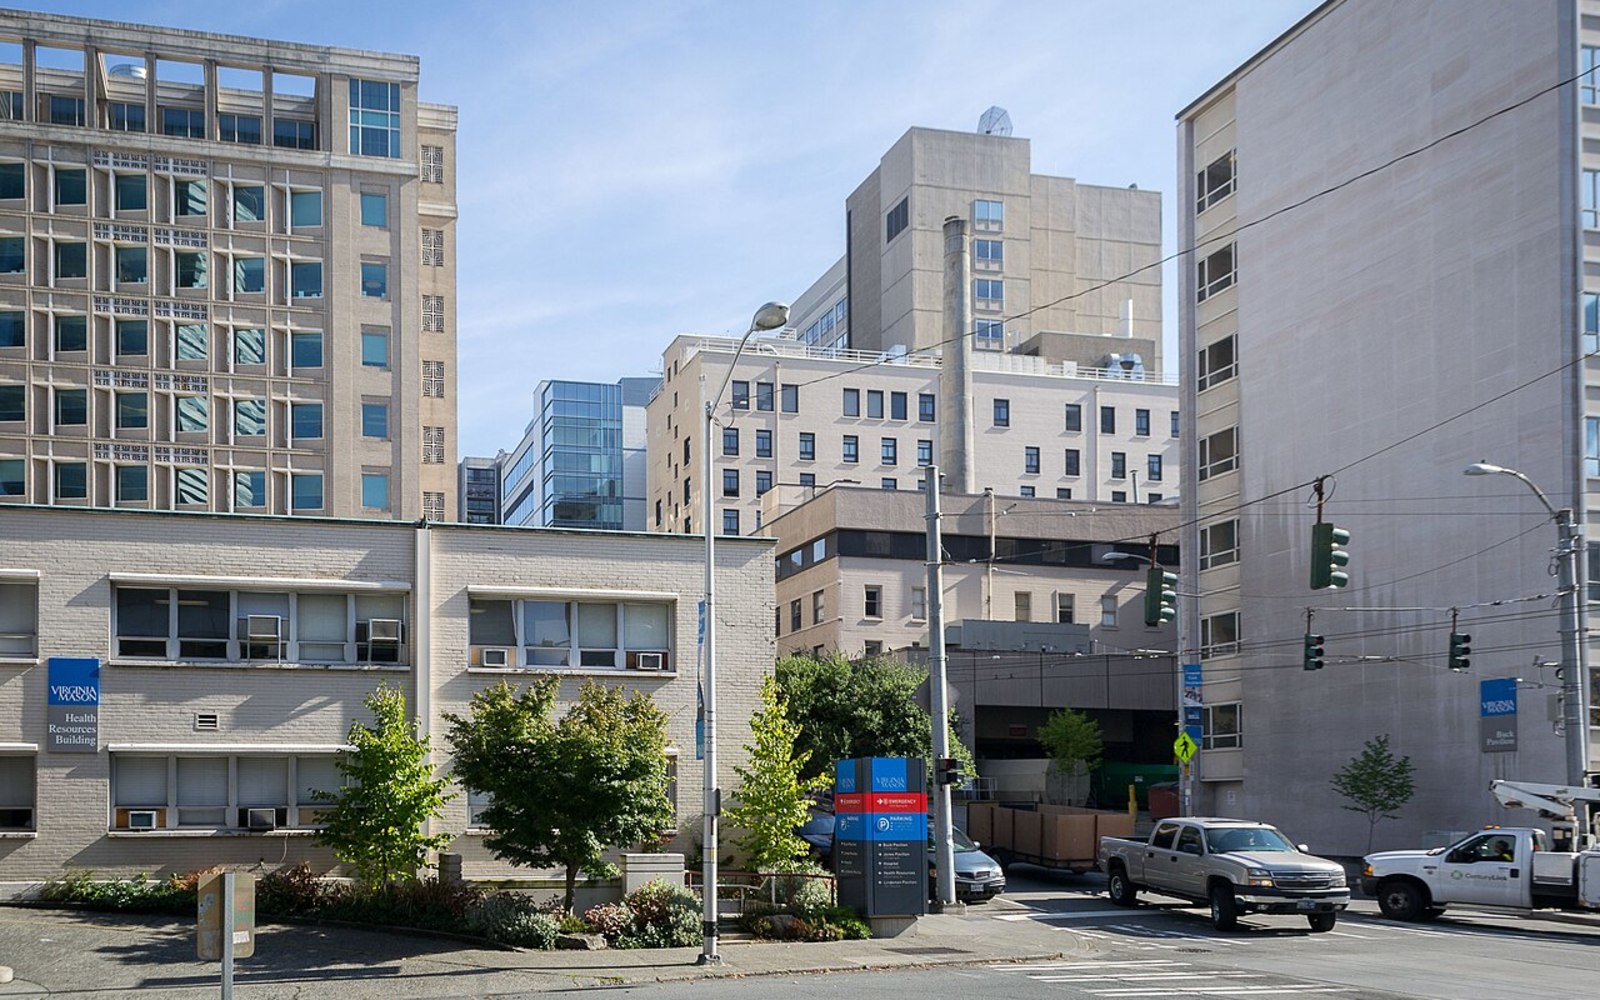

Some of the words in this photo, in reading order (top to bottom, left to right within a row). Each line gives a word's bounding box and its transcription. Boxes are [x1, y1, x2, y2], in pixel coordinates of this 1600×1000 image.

[51, 685, 97, 695] VIRGINIA
[59, 693, 97, 701] MASON
[65, 713, 97, 723] Health
[49, 724, 97, 734] Resources
[55, 734, 96, 747] Building
[1465, 872, 1507, 881] CenturyLink
